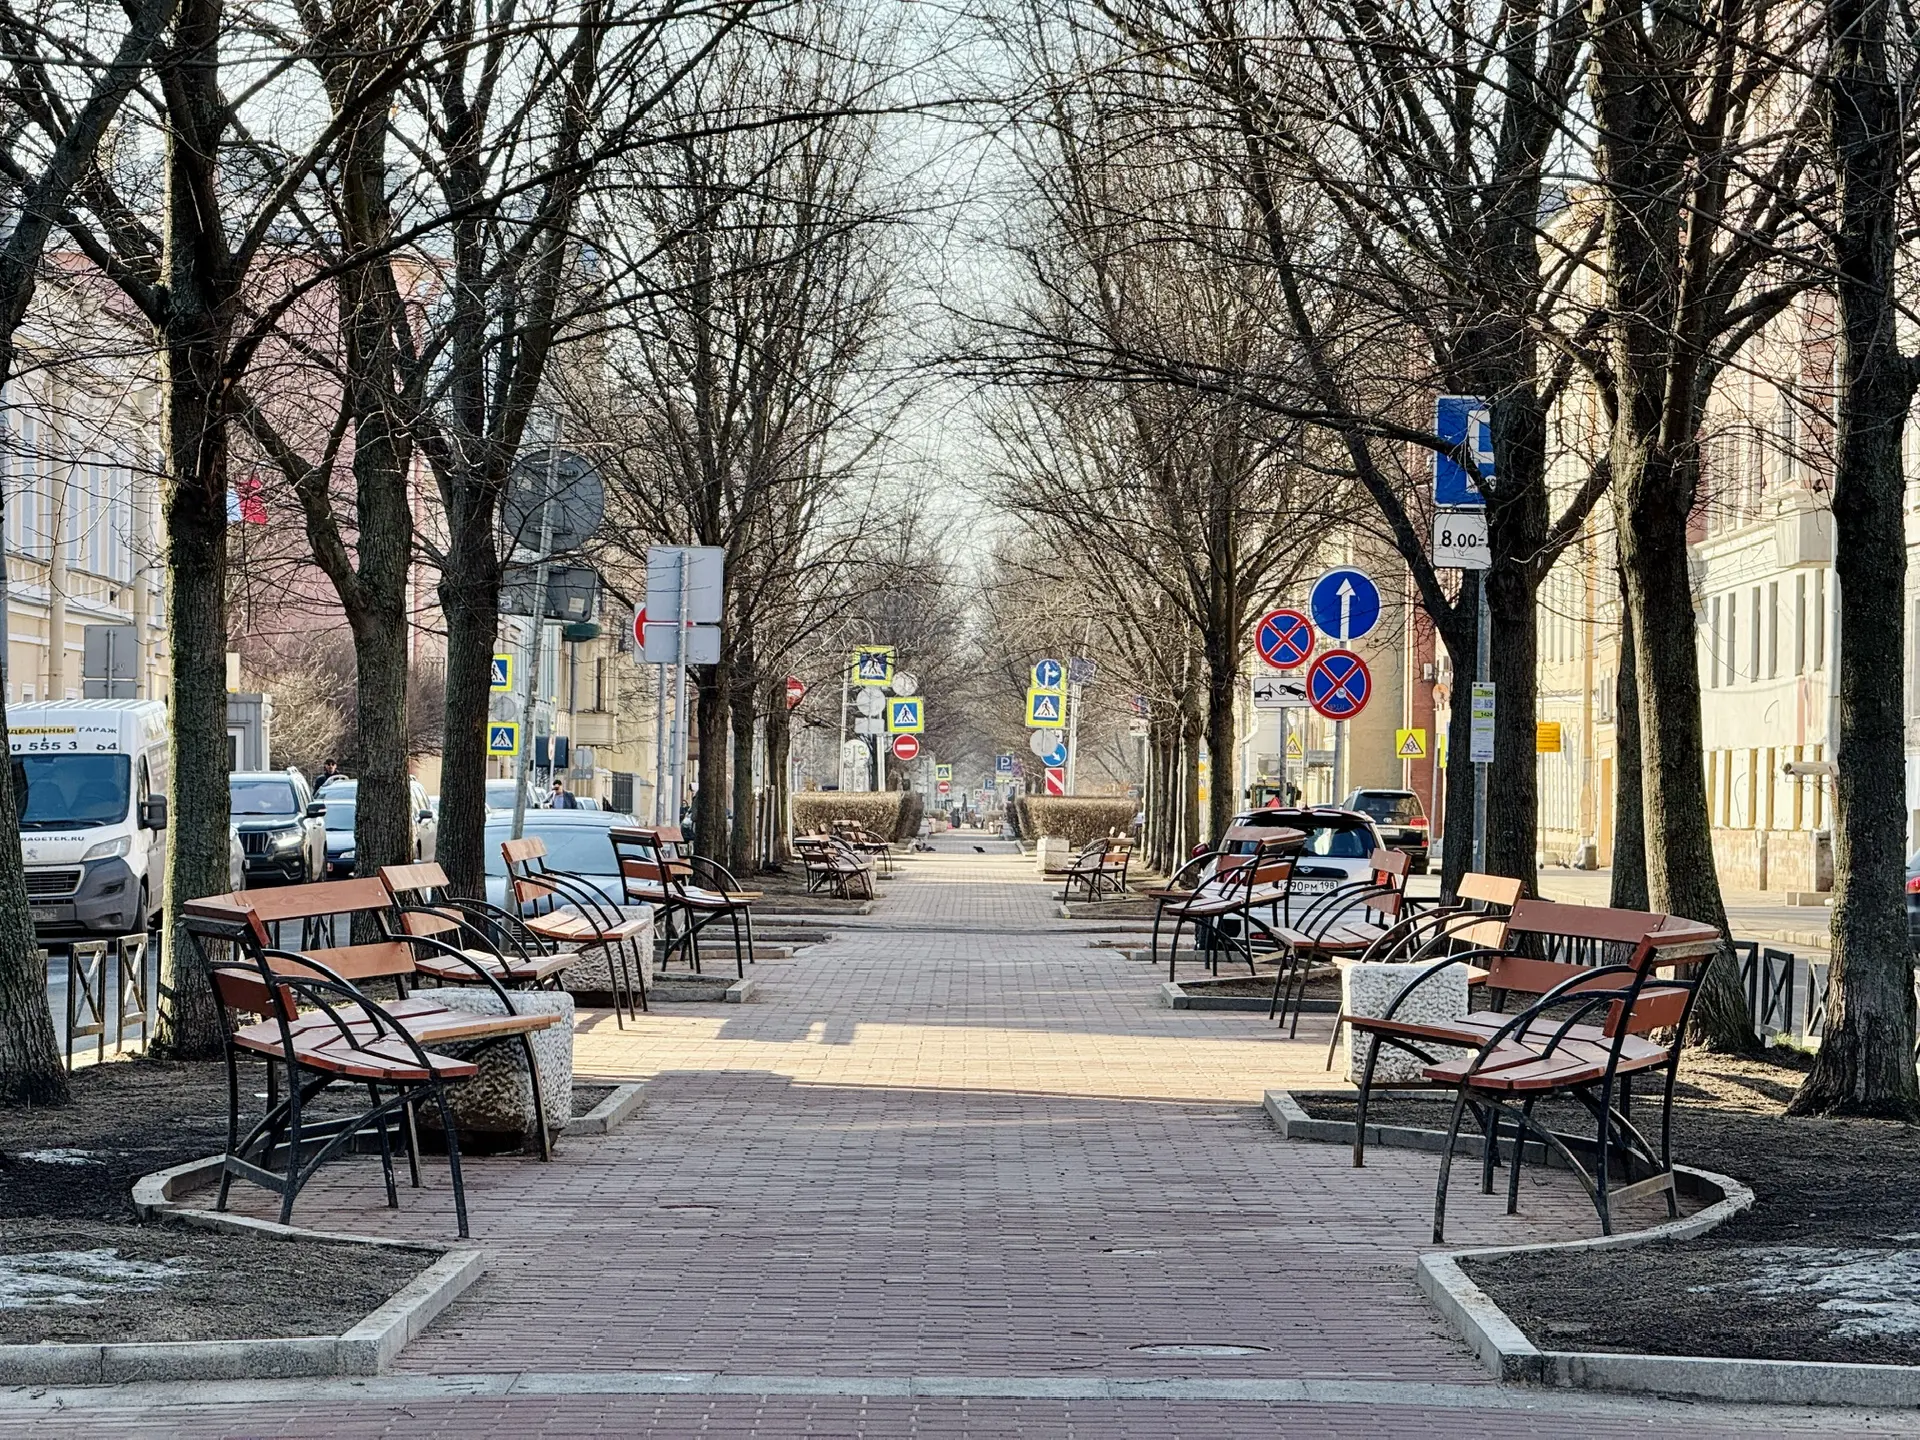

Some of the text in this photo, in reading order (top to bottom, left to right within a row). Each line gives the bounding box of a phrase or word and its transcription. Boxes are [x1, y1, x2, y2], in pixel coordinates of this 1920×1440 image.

[78, 726, 117, 734] ГАРАЖ
[28, 741, 61, 751] 555
[1320, 881, 1335, 890] 198
